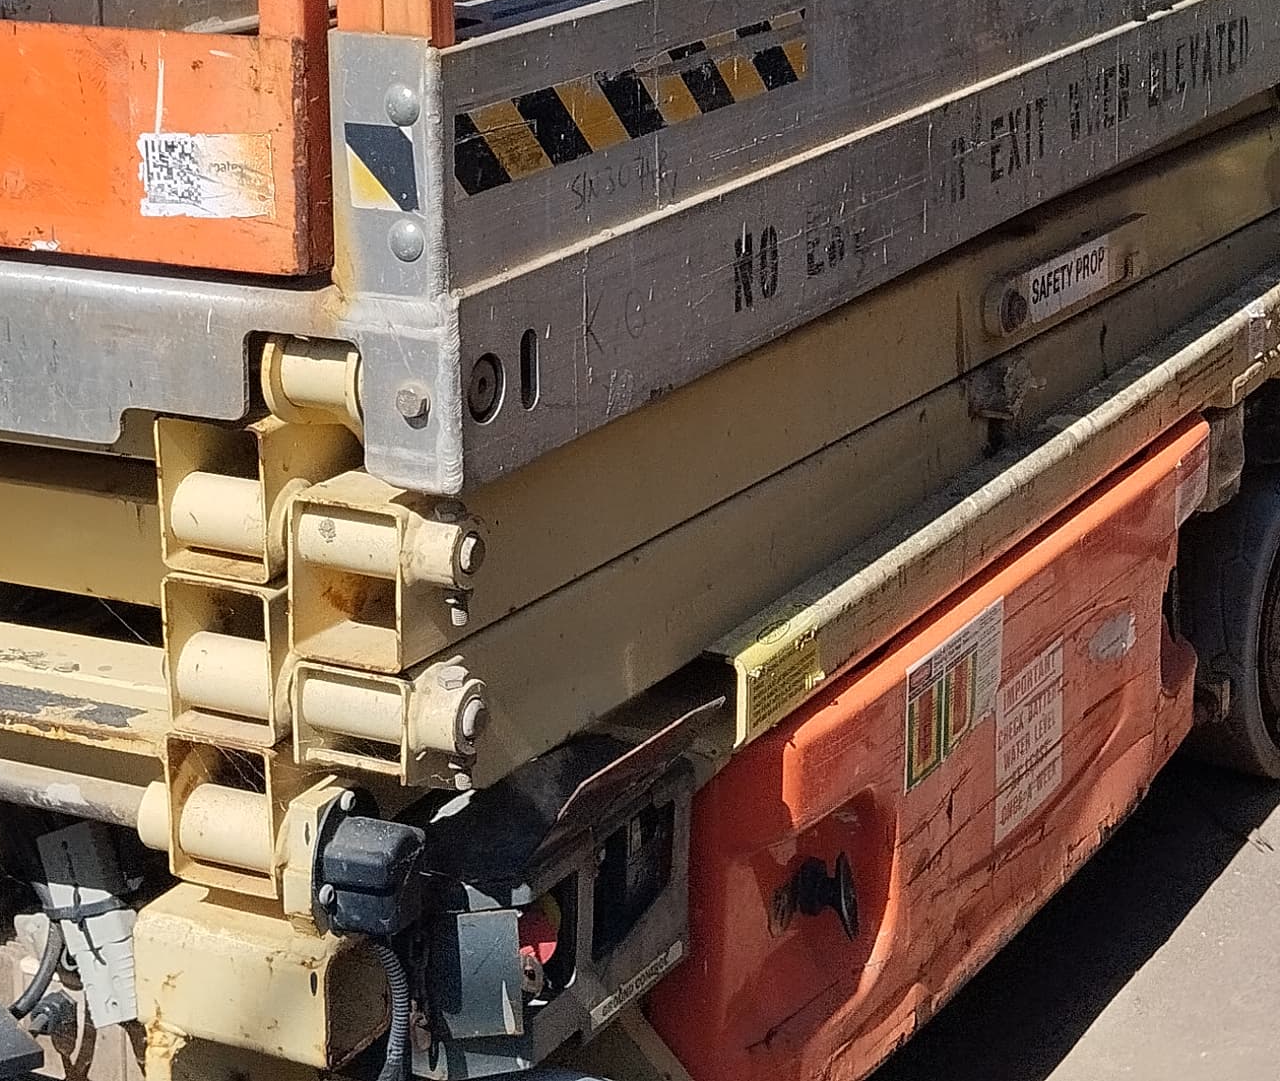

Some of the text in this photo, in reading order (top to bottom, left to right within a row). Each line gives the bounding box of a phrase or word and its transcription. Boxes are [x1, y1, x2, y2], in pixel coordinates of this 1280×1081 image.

[734, 225, 778, 313] NO
[990, 98, 1048, 184] EXIT
[1032, 246, 1105, 305] SAFETY PROP
[1003, 652, 1057, 711] IMPORTANT
[998, 713, 1024, 752] CHECK
[1003, 712, 1057, 771] WATER LEVEL
